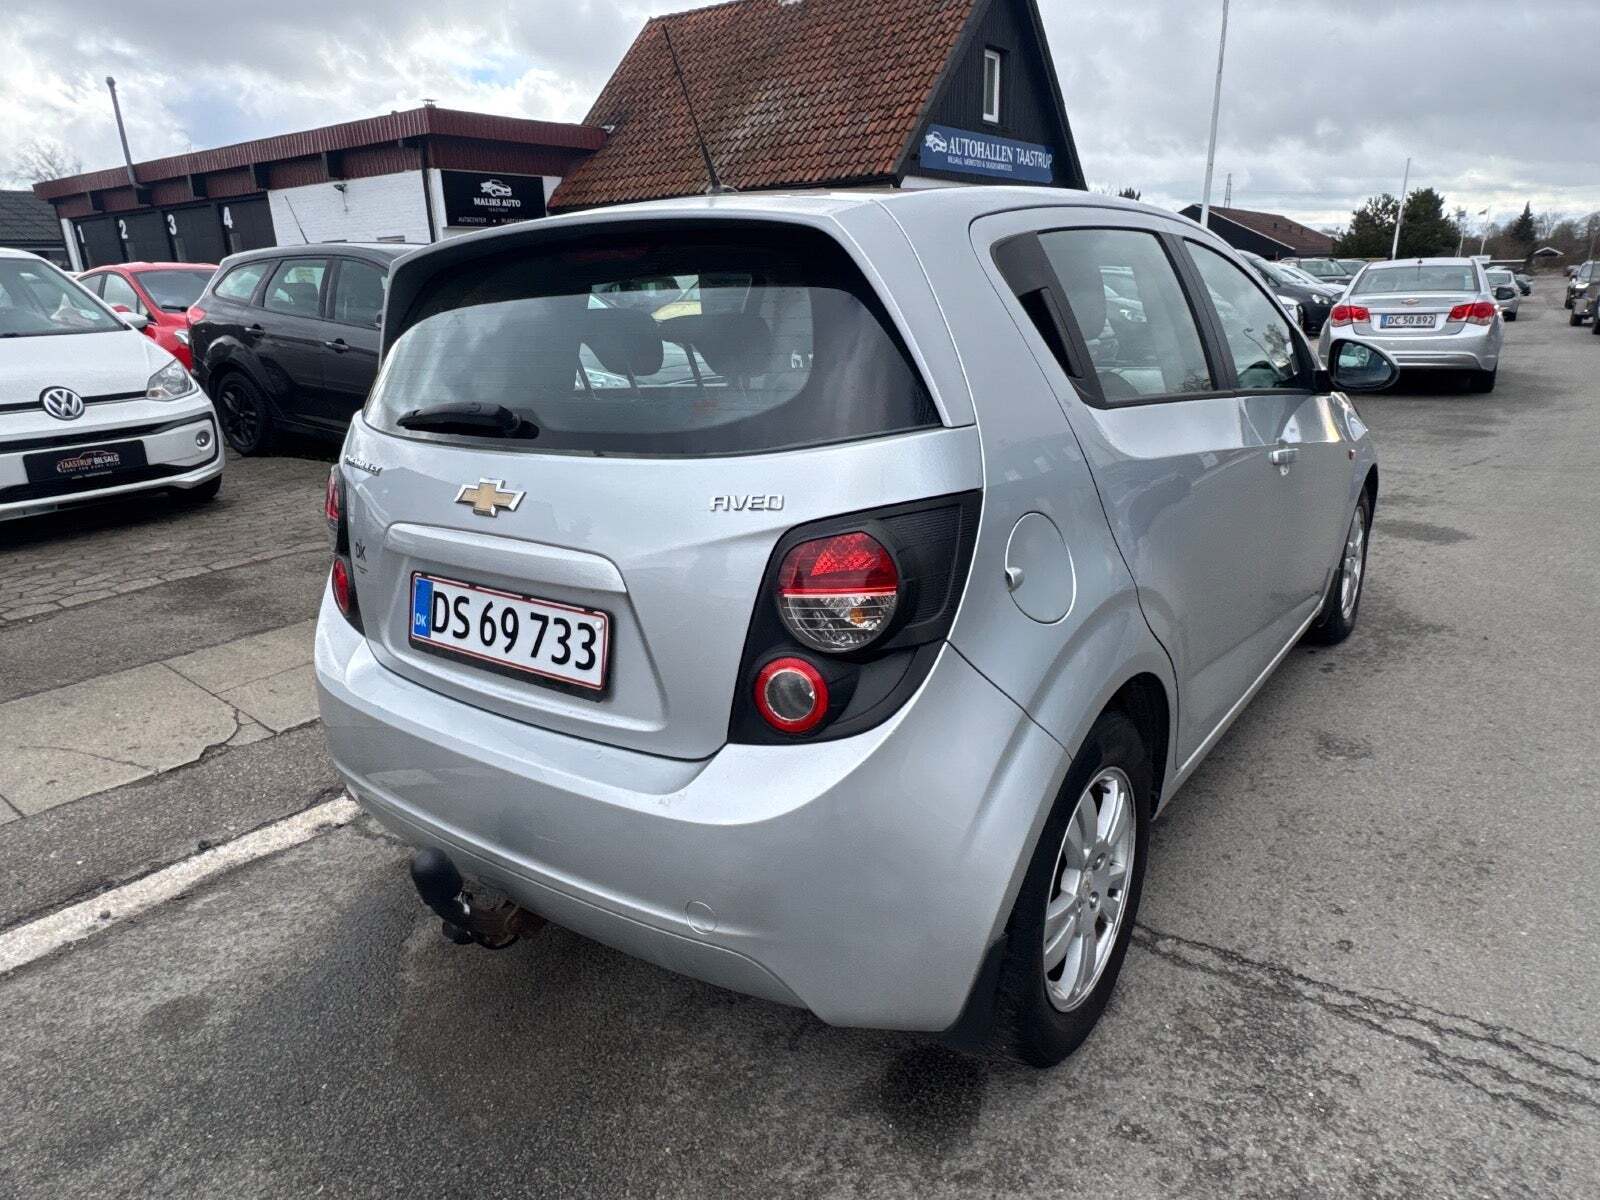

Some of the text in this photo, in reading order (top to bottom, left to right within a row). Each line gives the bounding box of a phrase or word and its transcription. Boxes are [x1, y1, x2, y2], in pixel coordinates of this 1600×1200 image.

[948, 137, 1013, 162] AUTOHALLEN
[1016, 148, 1052, 169] TAASTRUP
[473, 197, 521, 208] MALIKS AUTO
[167, 213, 177, 235] 3
[223, 207, 233, 228] 4
[77, 225, 85, 243] 1
[118, 219, 128, 240] 2
[1388, 315, 1434, 325] DC 50 892
[61, 457, 93, 469] TAASTRUP
[710, 494, 785, 512] AVEO
[355, 541, 367, 561] DK
[415, 612, 427, 628] DK
[431, 590, 597, 671] DS 69 733
